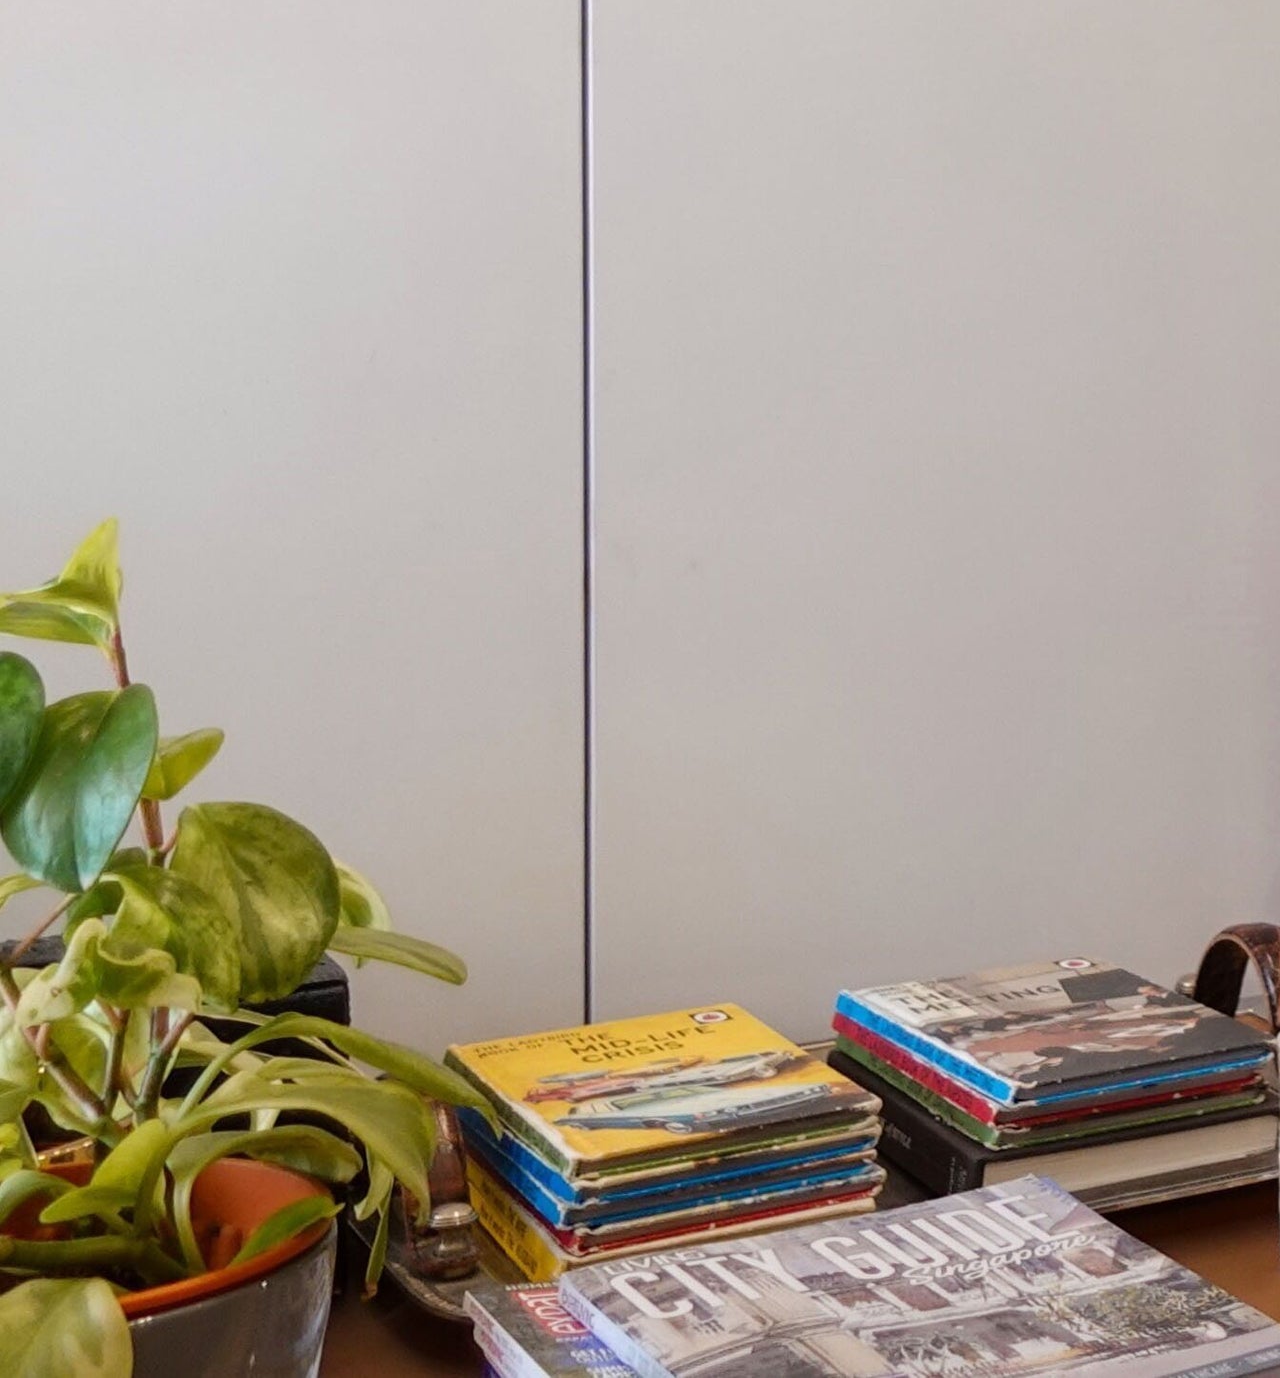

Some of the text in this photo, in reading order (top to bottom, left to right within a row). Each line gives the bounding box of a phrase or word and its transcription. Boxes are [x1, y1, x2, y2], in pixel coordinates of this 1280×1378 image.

[908, 984, 1064, 1016] MEETING
[560, 1030, 615, 1047] THE
[570, 1024, 717, 1056] MID-LIFE
[581, 1039, 685, 1065] CRISIS
[602, 1249, 706, 1276] LIVING
[611, 1246, 811, 1321] CITY
[810, 1195, 1082, 1282] GUIDE
[902, 1230, 1096, 1286] Singapore
